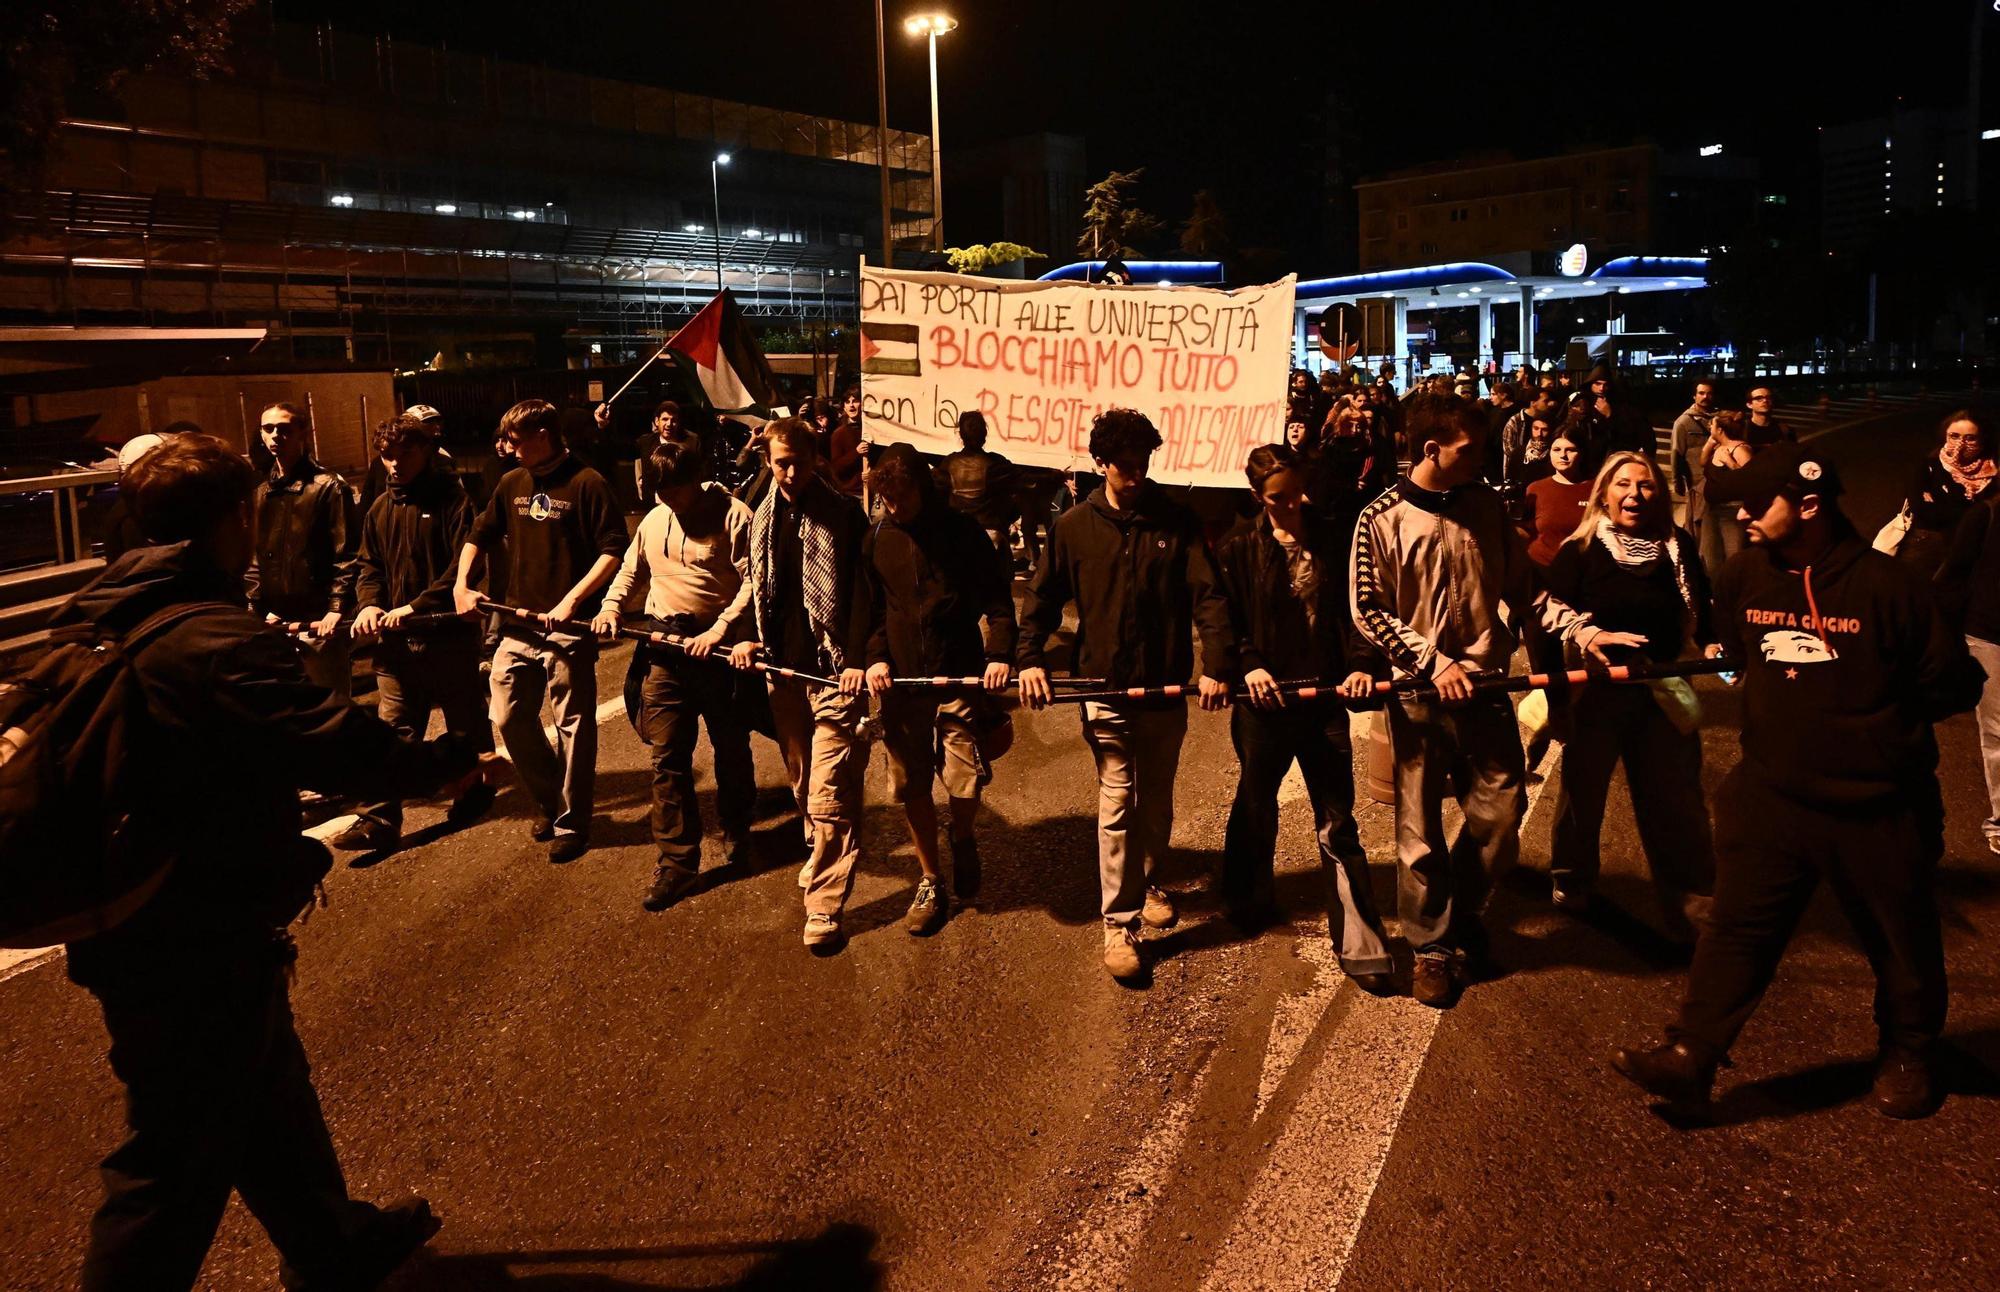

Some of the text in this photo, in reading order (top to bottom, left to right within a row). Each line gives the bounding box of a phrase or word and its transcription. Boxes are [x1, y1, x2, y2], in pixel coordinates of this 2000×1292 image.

[861, 278, 906, 314] DAI
[920, 284, 1002, 328] PORTI
[1014, 300, 1075, 333] ALLE
[930, 325, 1239, 393] BLOCCHIAMO TUTTO
[862, 393, 917, 426] con
[934, 384, 960, 429] la
[976, 388, 1125, 452] RESISTE
[1746, 609, 1797, 627] TRENTA
